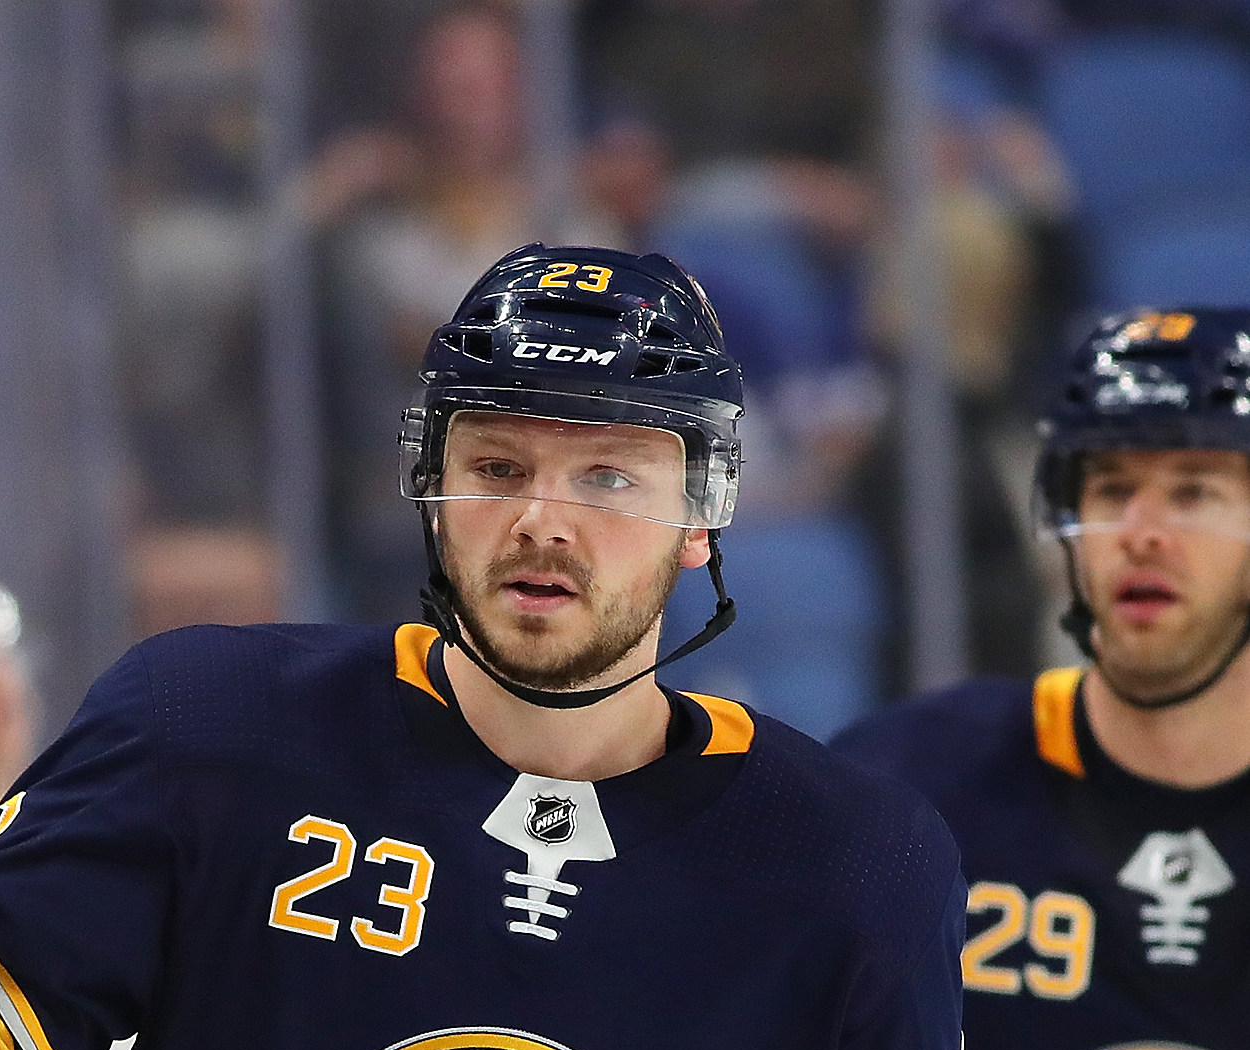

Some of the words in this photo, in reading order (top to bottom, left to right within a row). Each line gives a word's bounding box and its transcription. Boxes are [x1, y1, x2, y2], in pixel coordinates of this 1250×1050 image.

[538, 262, 614, 294] 23
[511, 342, 618, 366] CCM
[535, 807, 568, 832] NHL
[268, 814, 436, 957] 23
[960, 881, 1096, 1001] 29
